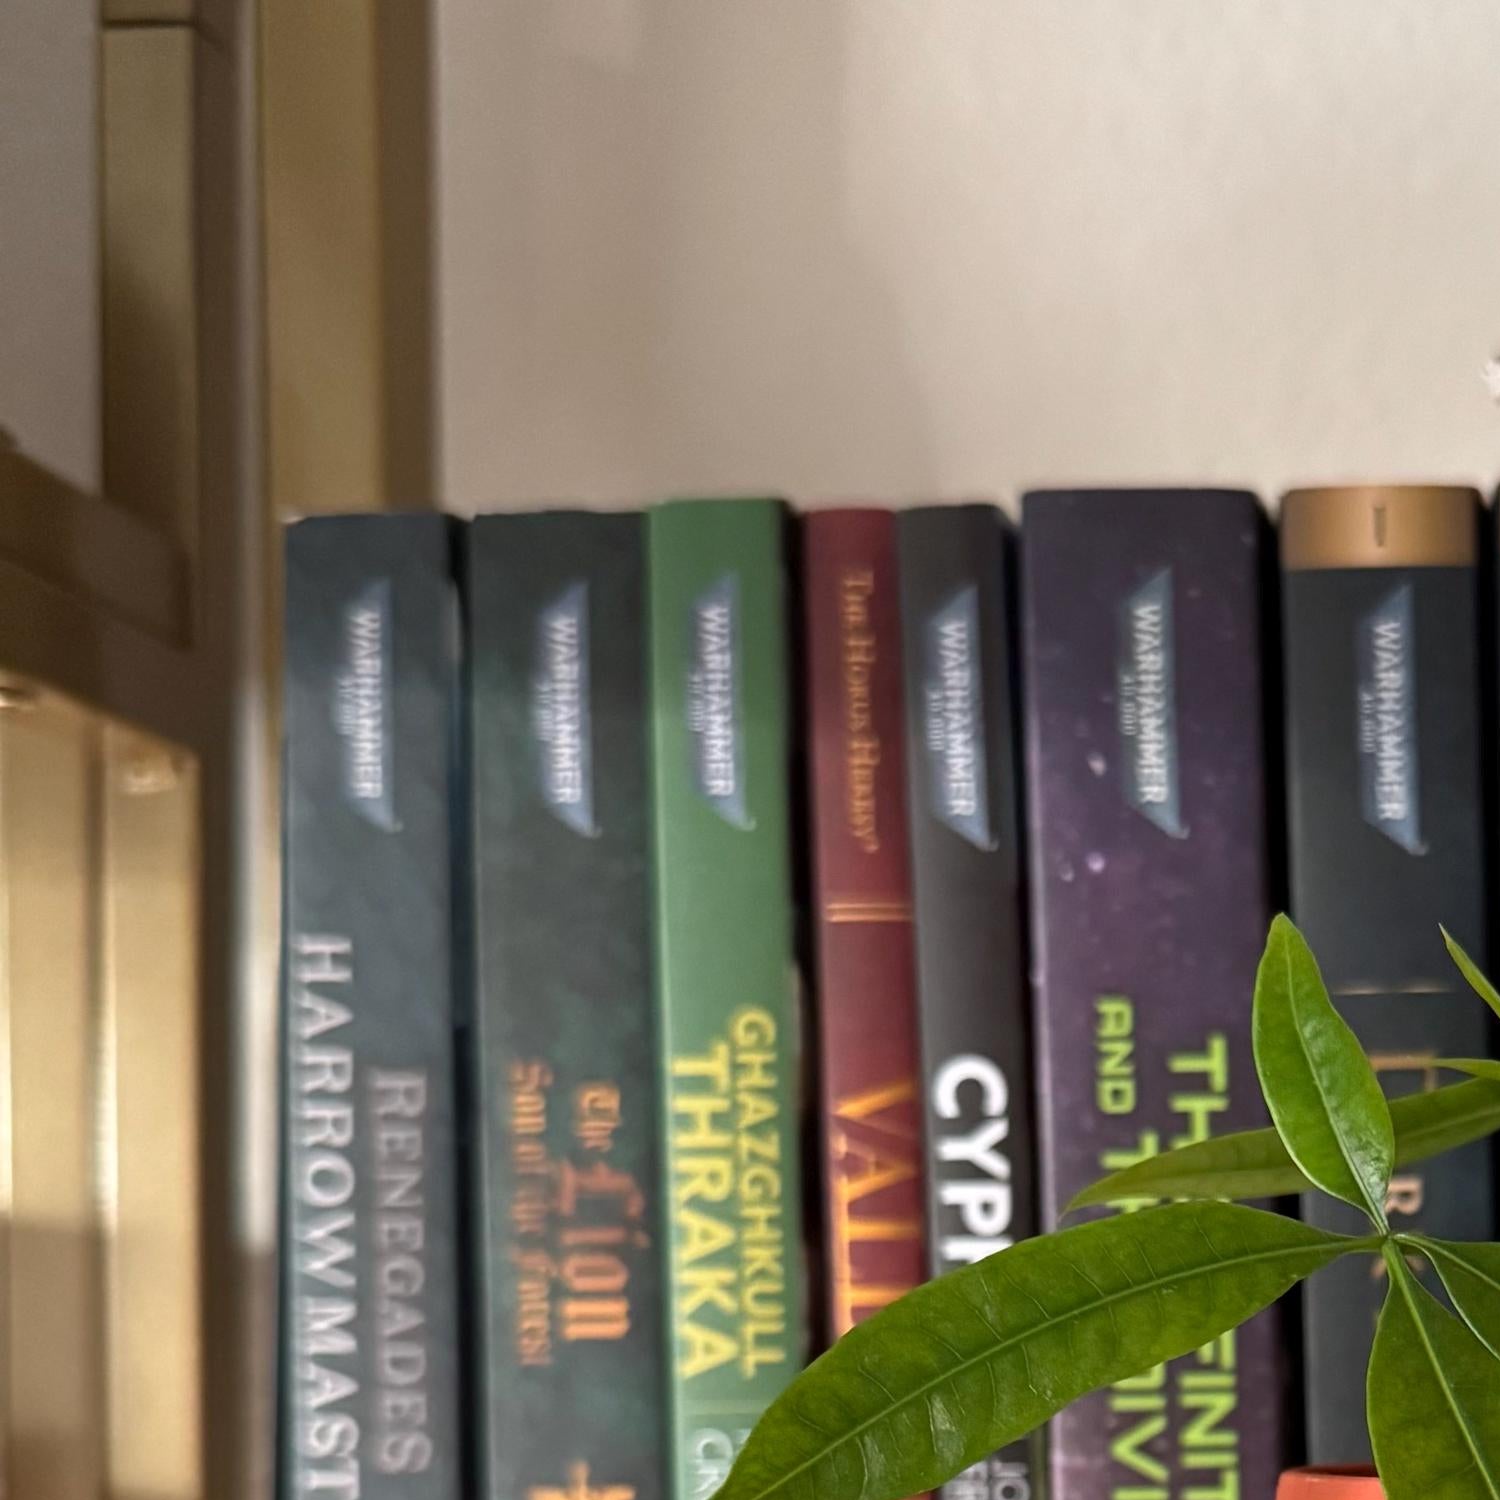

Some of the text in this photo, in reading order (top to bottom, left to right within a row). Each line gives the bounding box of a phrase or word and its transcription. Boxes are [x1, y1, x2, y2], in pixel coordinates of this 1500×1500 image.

[351, 607, 384, 799] WARHAMMER
[549, 614, 583, 803] WARHAMMER
[701, 605, 735, 796] WARHAMMER
[939, 621, 977, 816] WARHAMMER
[1133, 603, 1169, 805] WARHAMMER
[1373, 621, 1407, 820] WARHAMMER
[1095, 997, 1136, 1115] AND
[369, 1065, 433, 1475] RENEGADES
[555, 1159, 650, 1343] Lion
[669, 1039, 740, 1382] THRAKA
[729, 1004, 787, 1380] GHAZGHKULL
